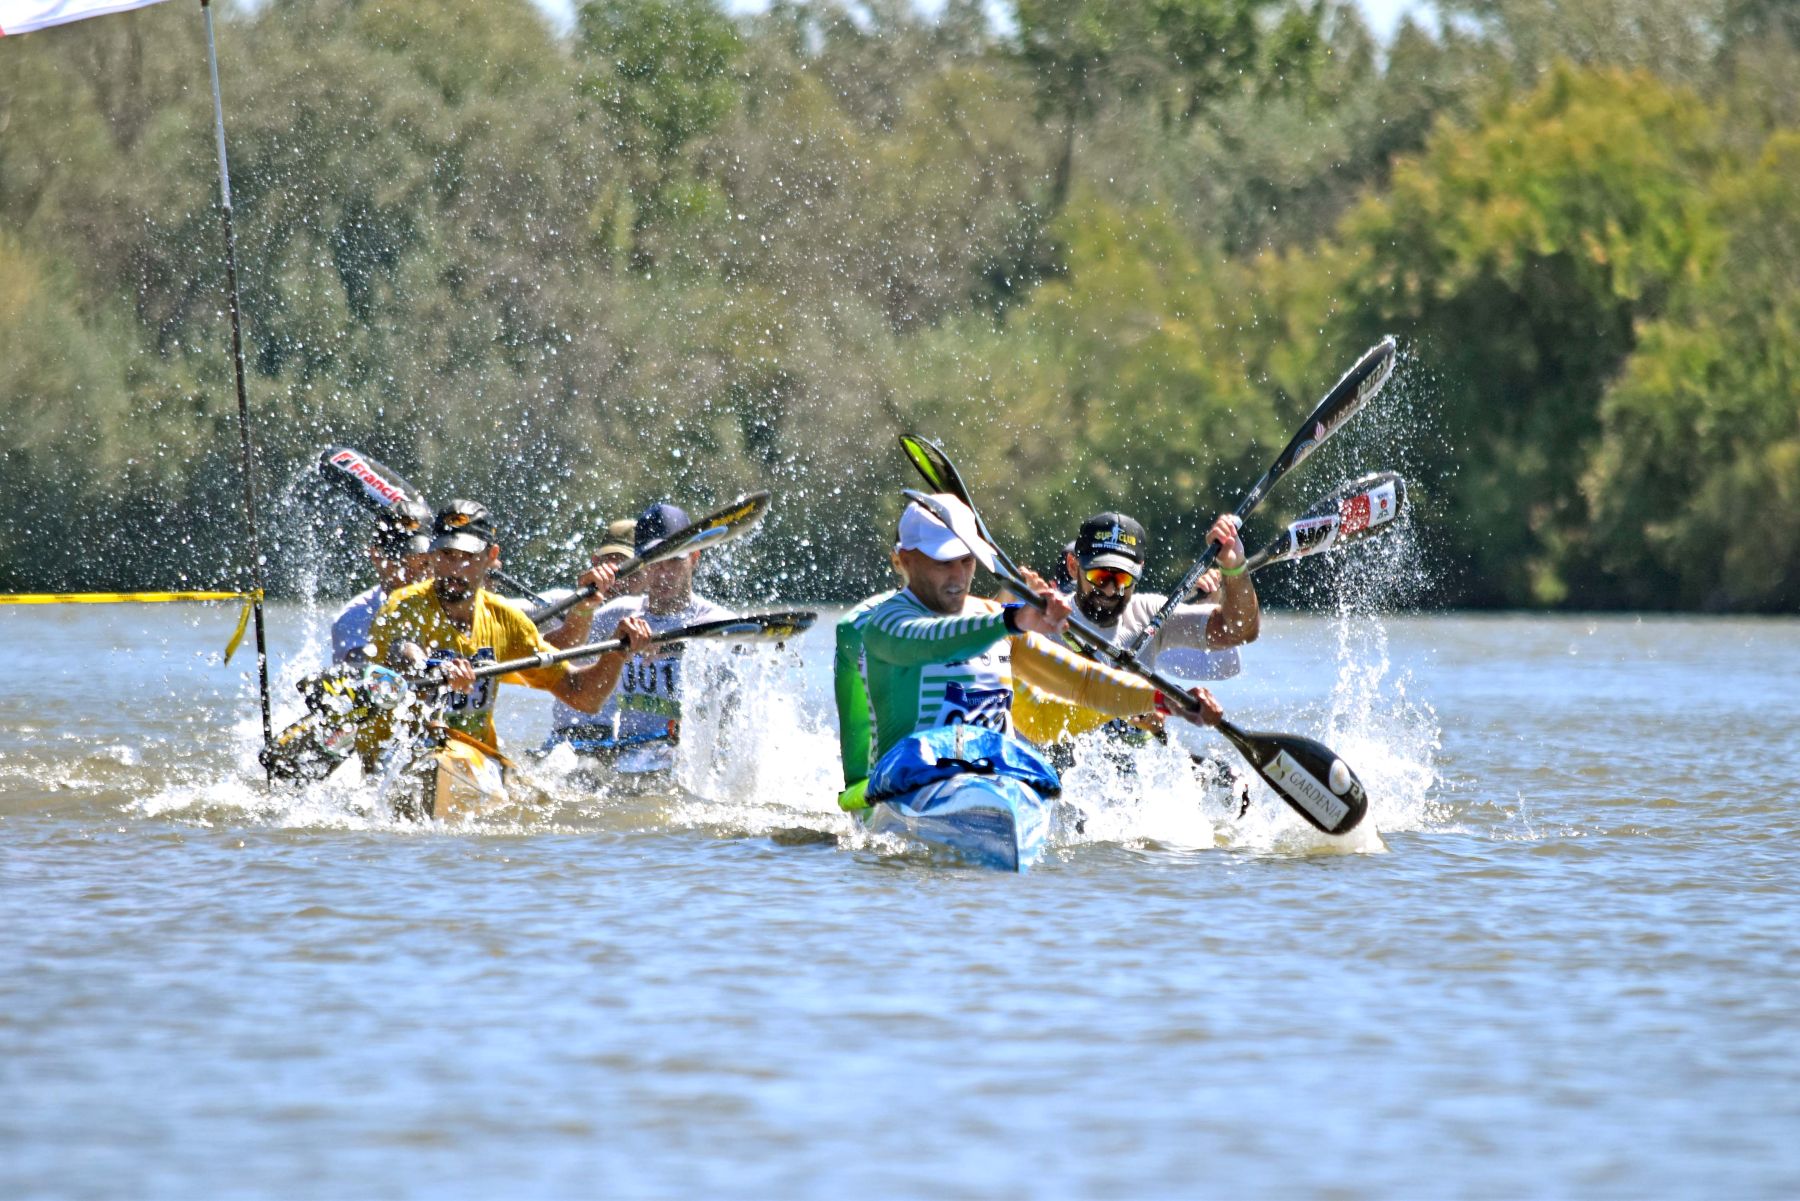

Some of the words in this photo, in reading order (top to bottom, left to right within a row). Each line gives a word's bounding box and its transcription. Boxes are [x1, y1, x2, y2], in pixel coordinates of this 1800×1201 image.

[1094, 531, 1112, 540] SUP
[1118, 534, 1137, 546] CLUB
[1289, 771, 1342, 819] GARDENIA
